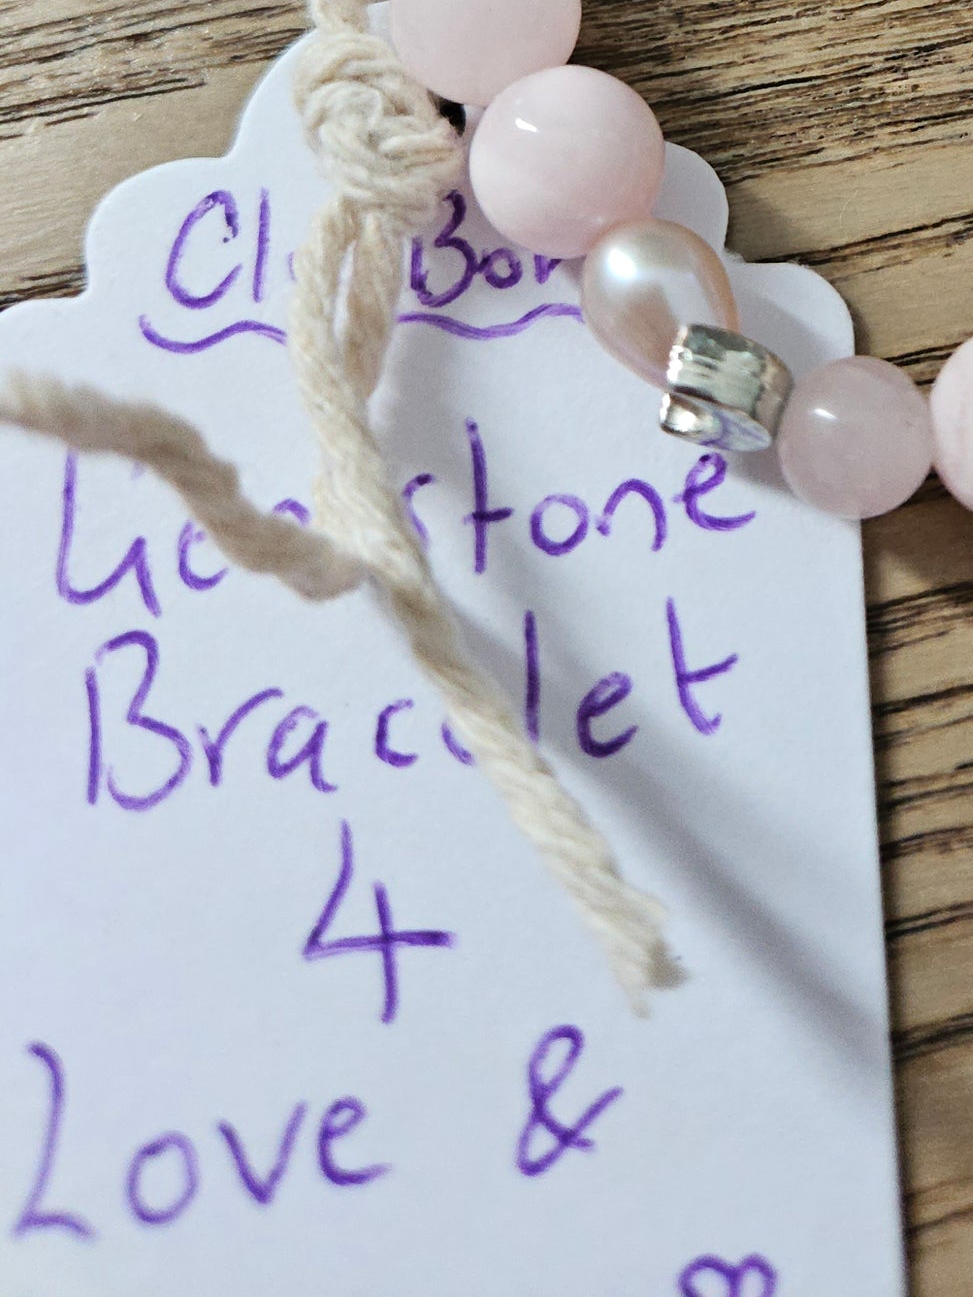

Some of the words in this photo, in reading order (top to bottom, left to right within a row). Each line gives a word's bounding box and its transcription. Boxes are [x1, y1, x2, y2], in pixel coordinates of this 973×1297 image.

[302, 819, 456, 1024] 4
[11, 1040, 393, 1241] Love
[515, 1023, 625, 1177] &
